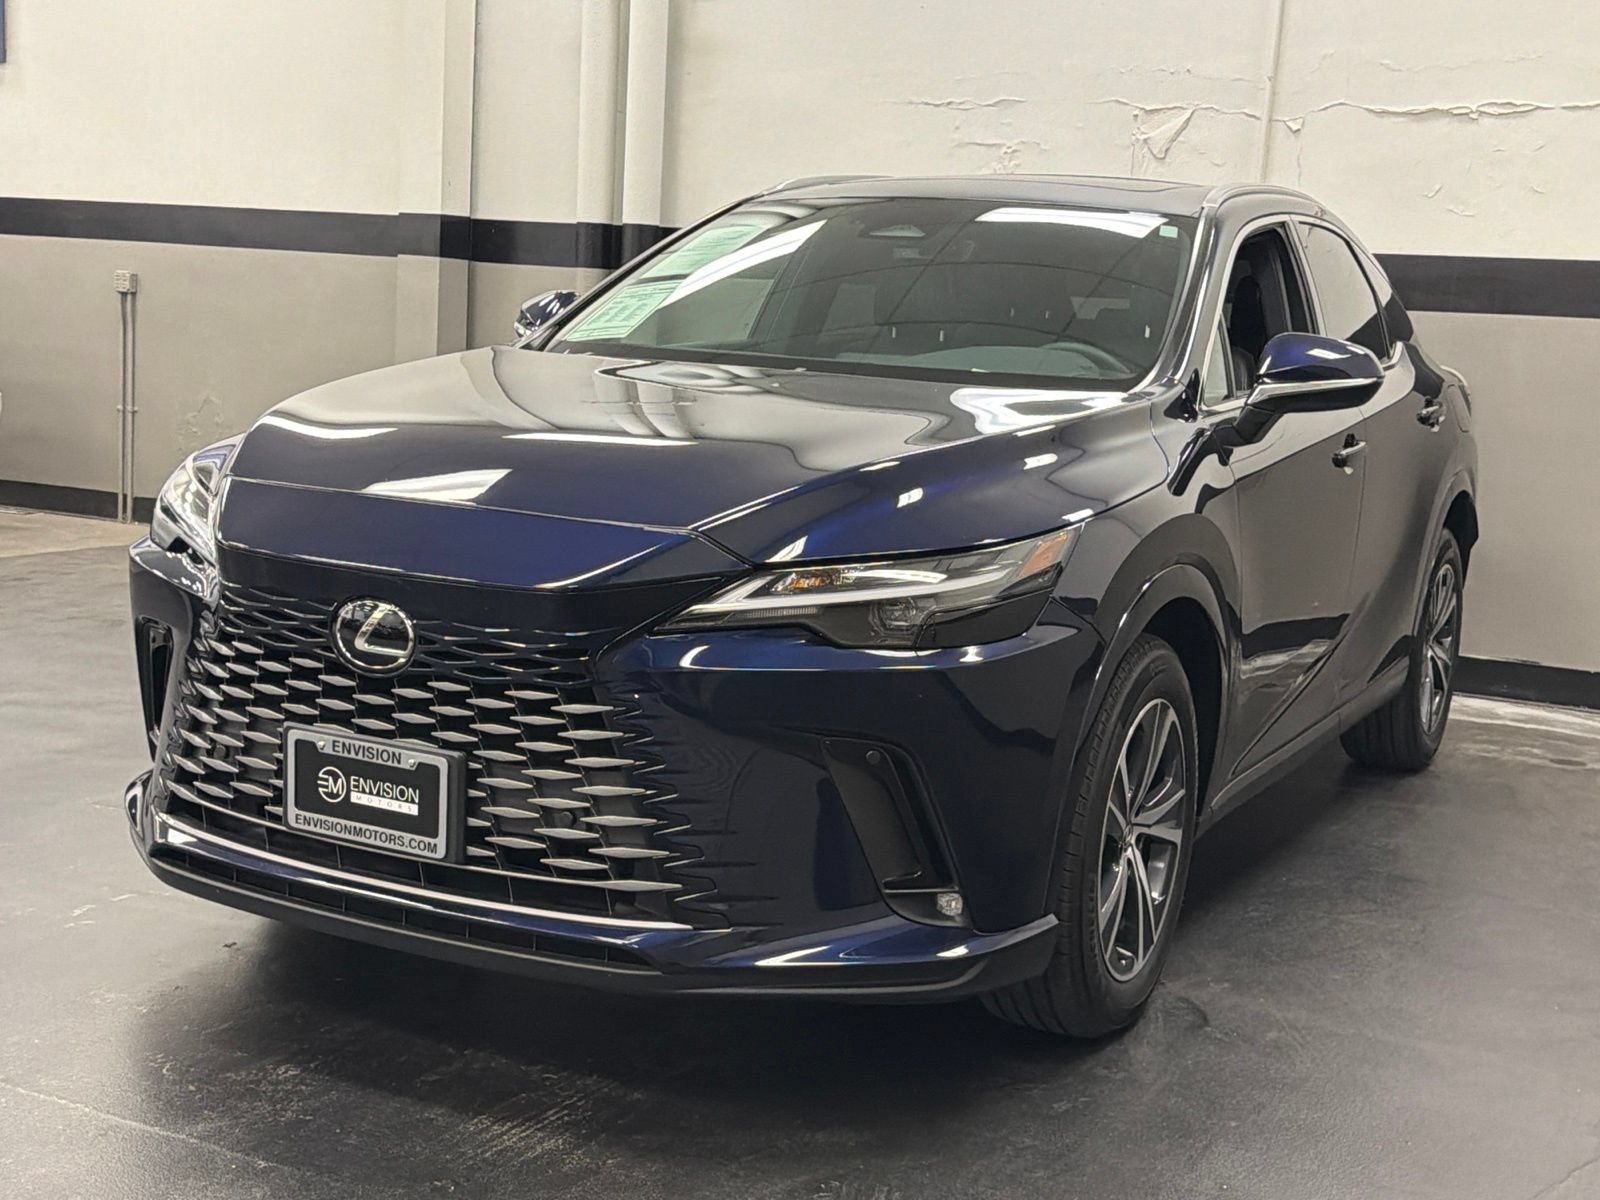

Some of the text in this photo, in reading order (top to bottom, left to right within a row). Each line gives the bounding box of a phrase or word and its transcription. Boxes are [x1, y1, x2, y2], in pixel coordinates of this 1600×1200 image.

[332, 740, 402, 765] ENVISION
[350, 776, 419, 803] ENVISION
[355, 795, 412, 812] MOTORS
[295, 814, 438, 854] ENVISIONMOTORS.COM
